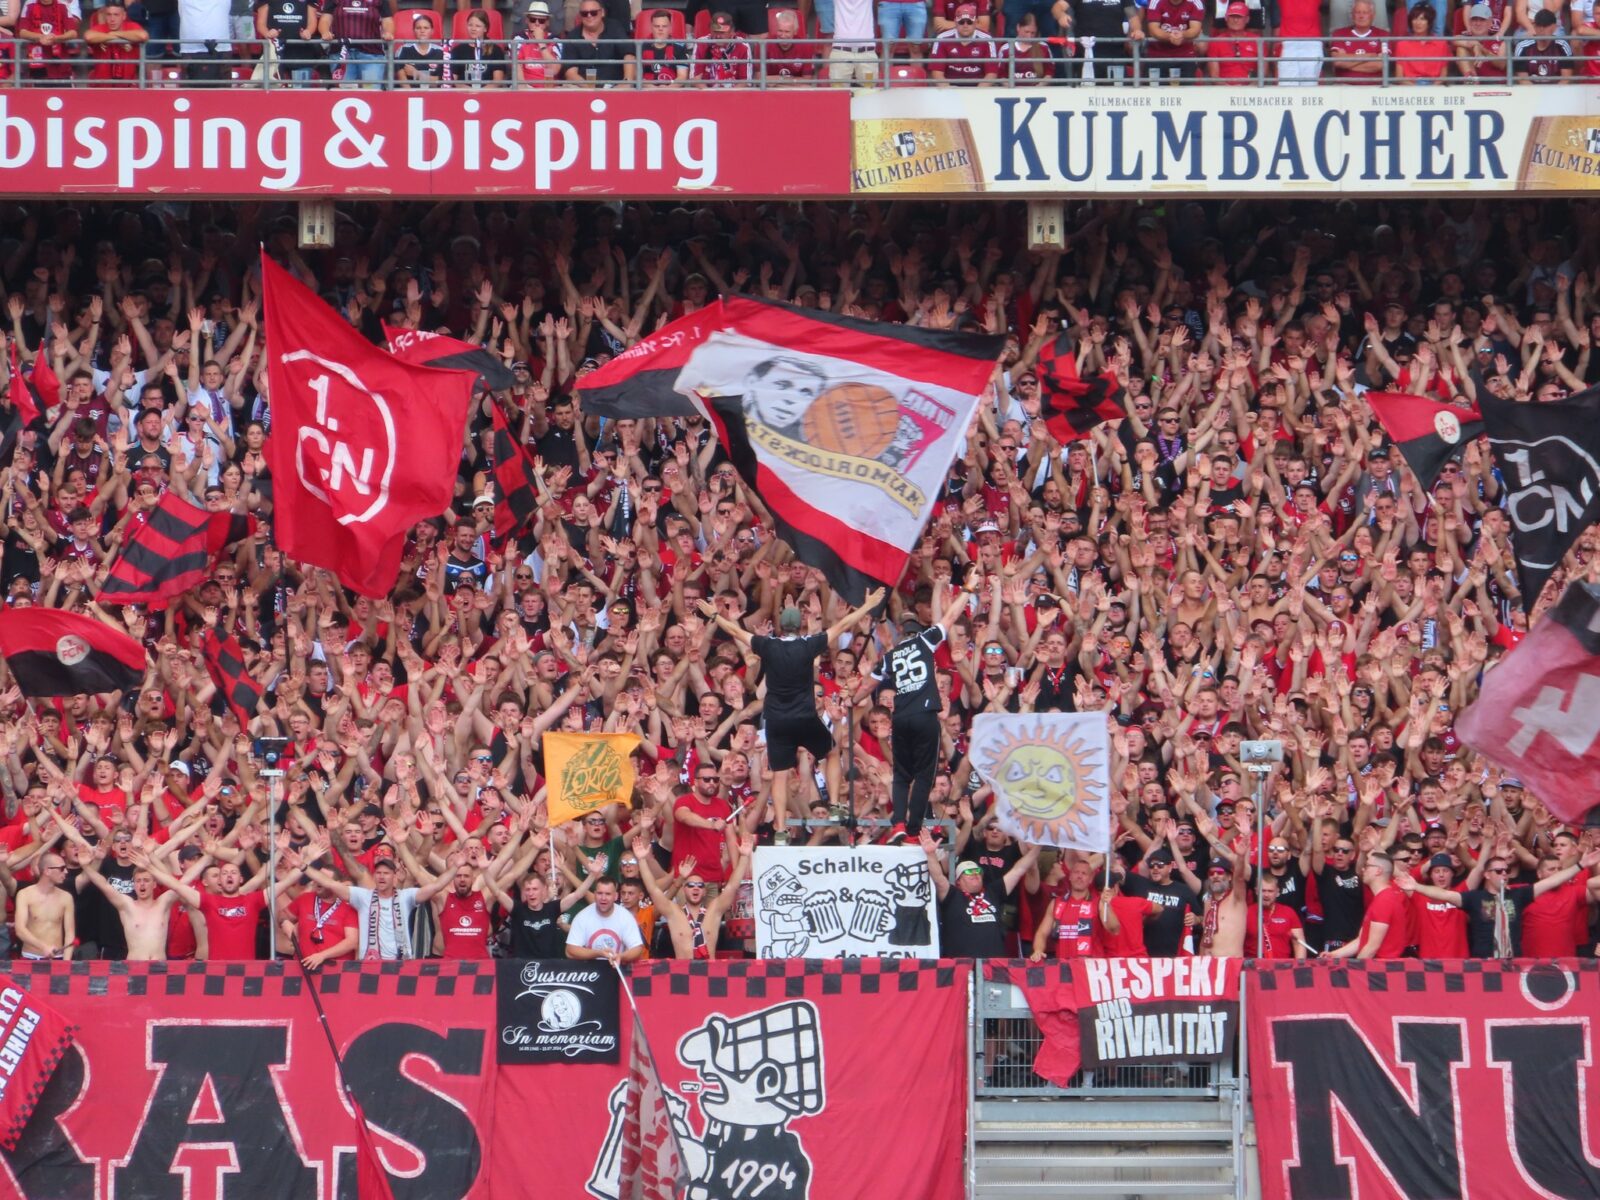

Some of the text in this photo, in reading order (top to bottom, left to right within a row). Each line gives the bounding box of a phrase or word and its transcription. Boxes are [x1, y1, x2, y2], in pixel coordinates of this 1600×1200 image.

[1088, 97, 1183, 107] KULMBACHER BIER
[1230, 97, 1324, 107] KULMBACHER BIER
[1371, 96, 1466, 106] KULMBACHER BIER
[0, 97, 718, 190] bisping & bisping
[994, 97, 1509, 182] KULMBACHER
[853, 148, 969, 190] KULMBACHER
[892, 650, 928, 689] 25
[798, 857, 883, 876] Schalke
[839, 887, 854, 903] &
[520, 961, 600, 986] Susanne
[1096, 997, 1133, 1022] UND
[502, 1026, 616, 1046] In memoriam
[1095, 1005, 1228, 1060] RIVALITÄT
[720, 1158, 797, 1199] 1994
